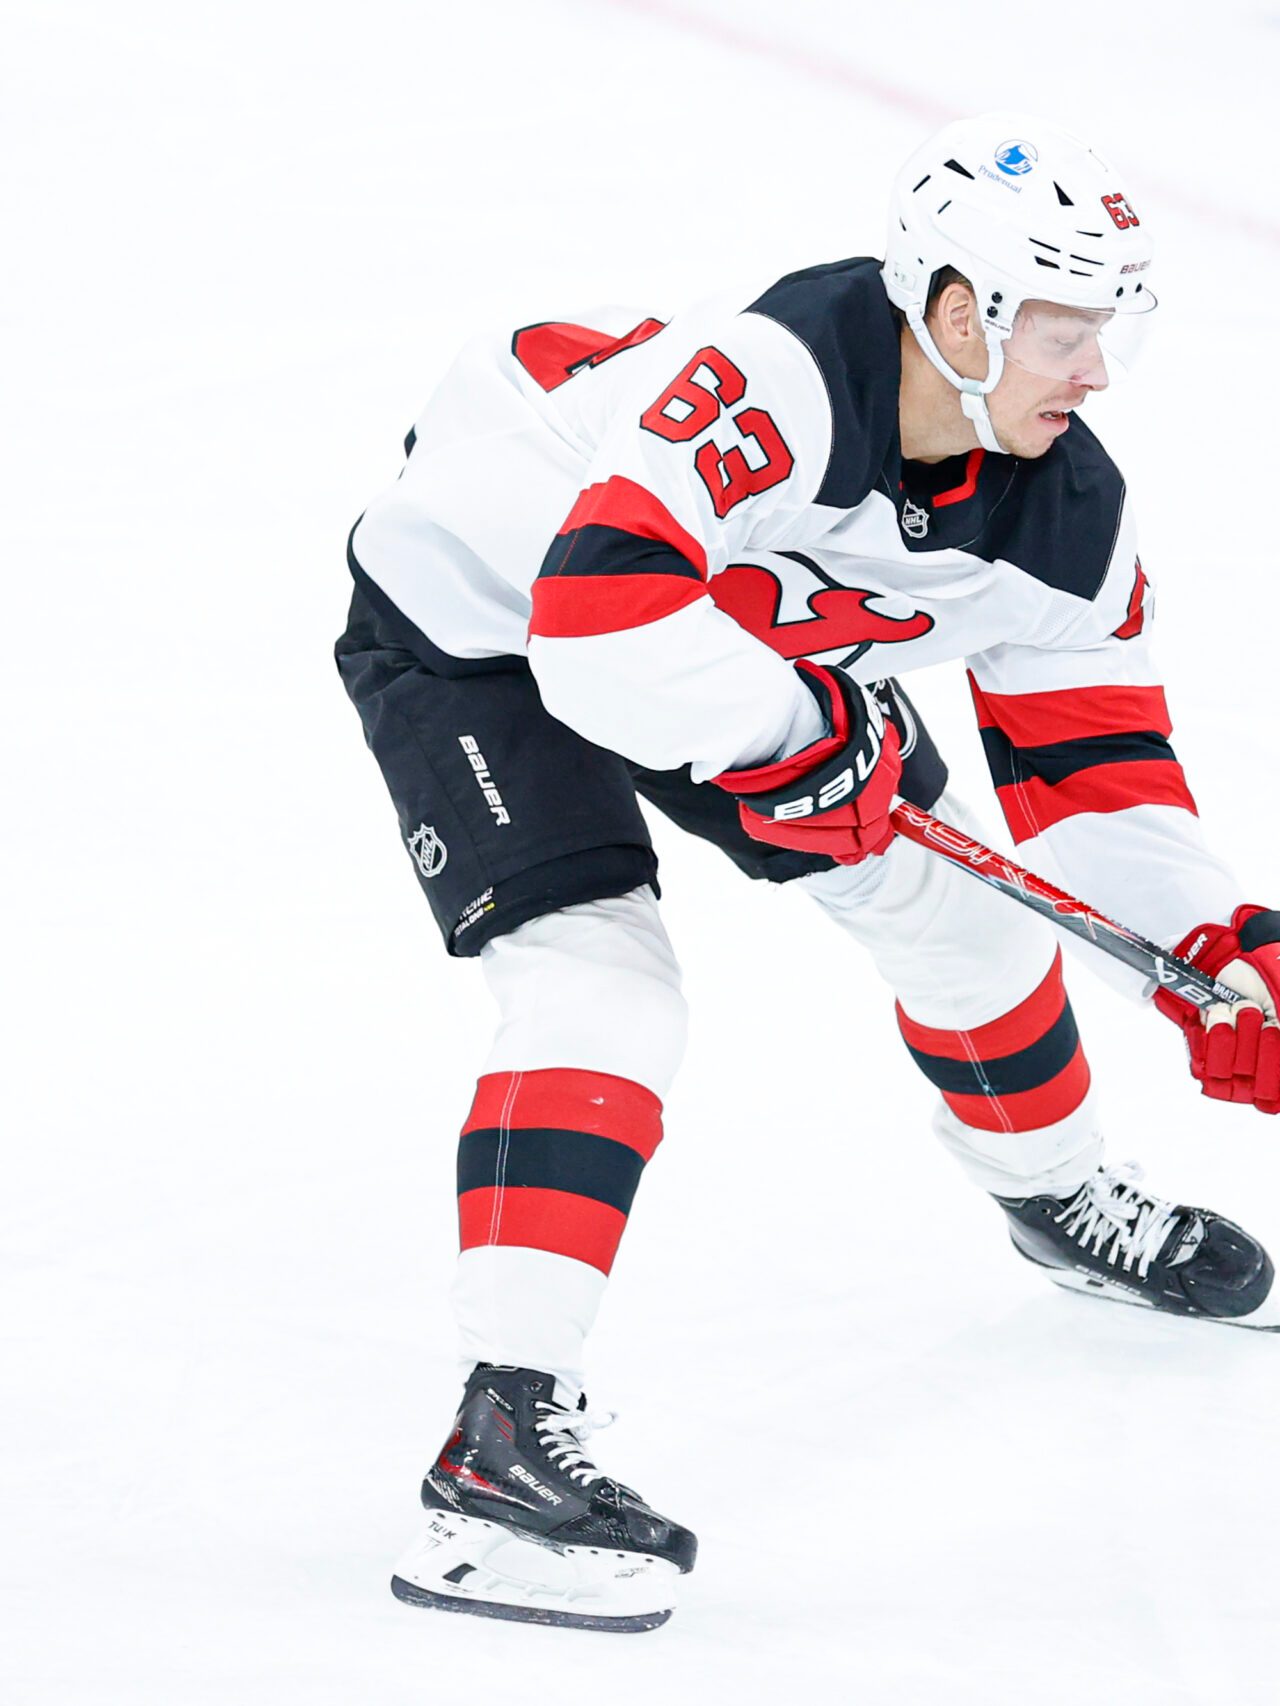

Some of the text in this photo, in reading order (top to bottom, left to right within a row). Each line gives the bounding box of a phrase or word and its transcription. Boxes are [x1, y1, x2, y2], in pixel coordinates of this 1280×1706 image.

[639, 345, 795, 520] 63
[458, 735, 511, 826] BAUER
[774, 686, 885, 821] BAU
[1183, 933, 1208, 965] UER
[1212, 982, 1240, 1003] BRATT
[509, 1464, 563, 1506] BAUER
